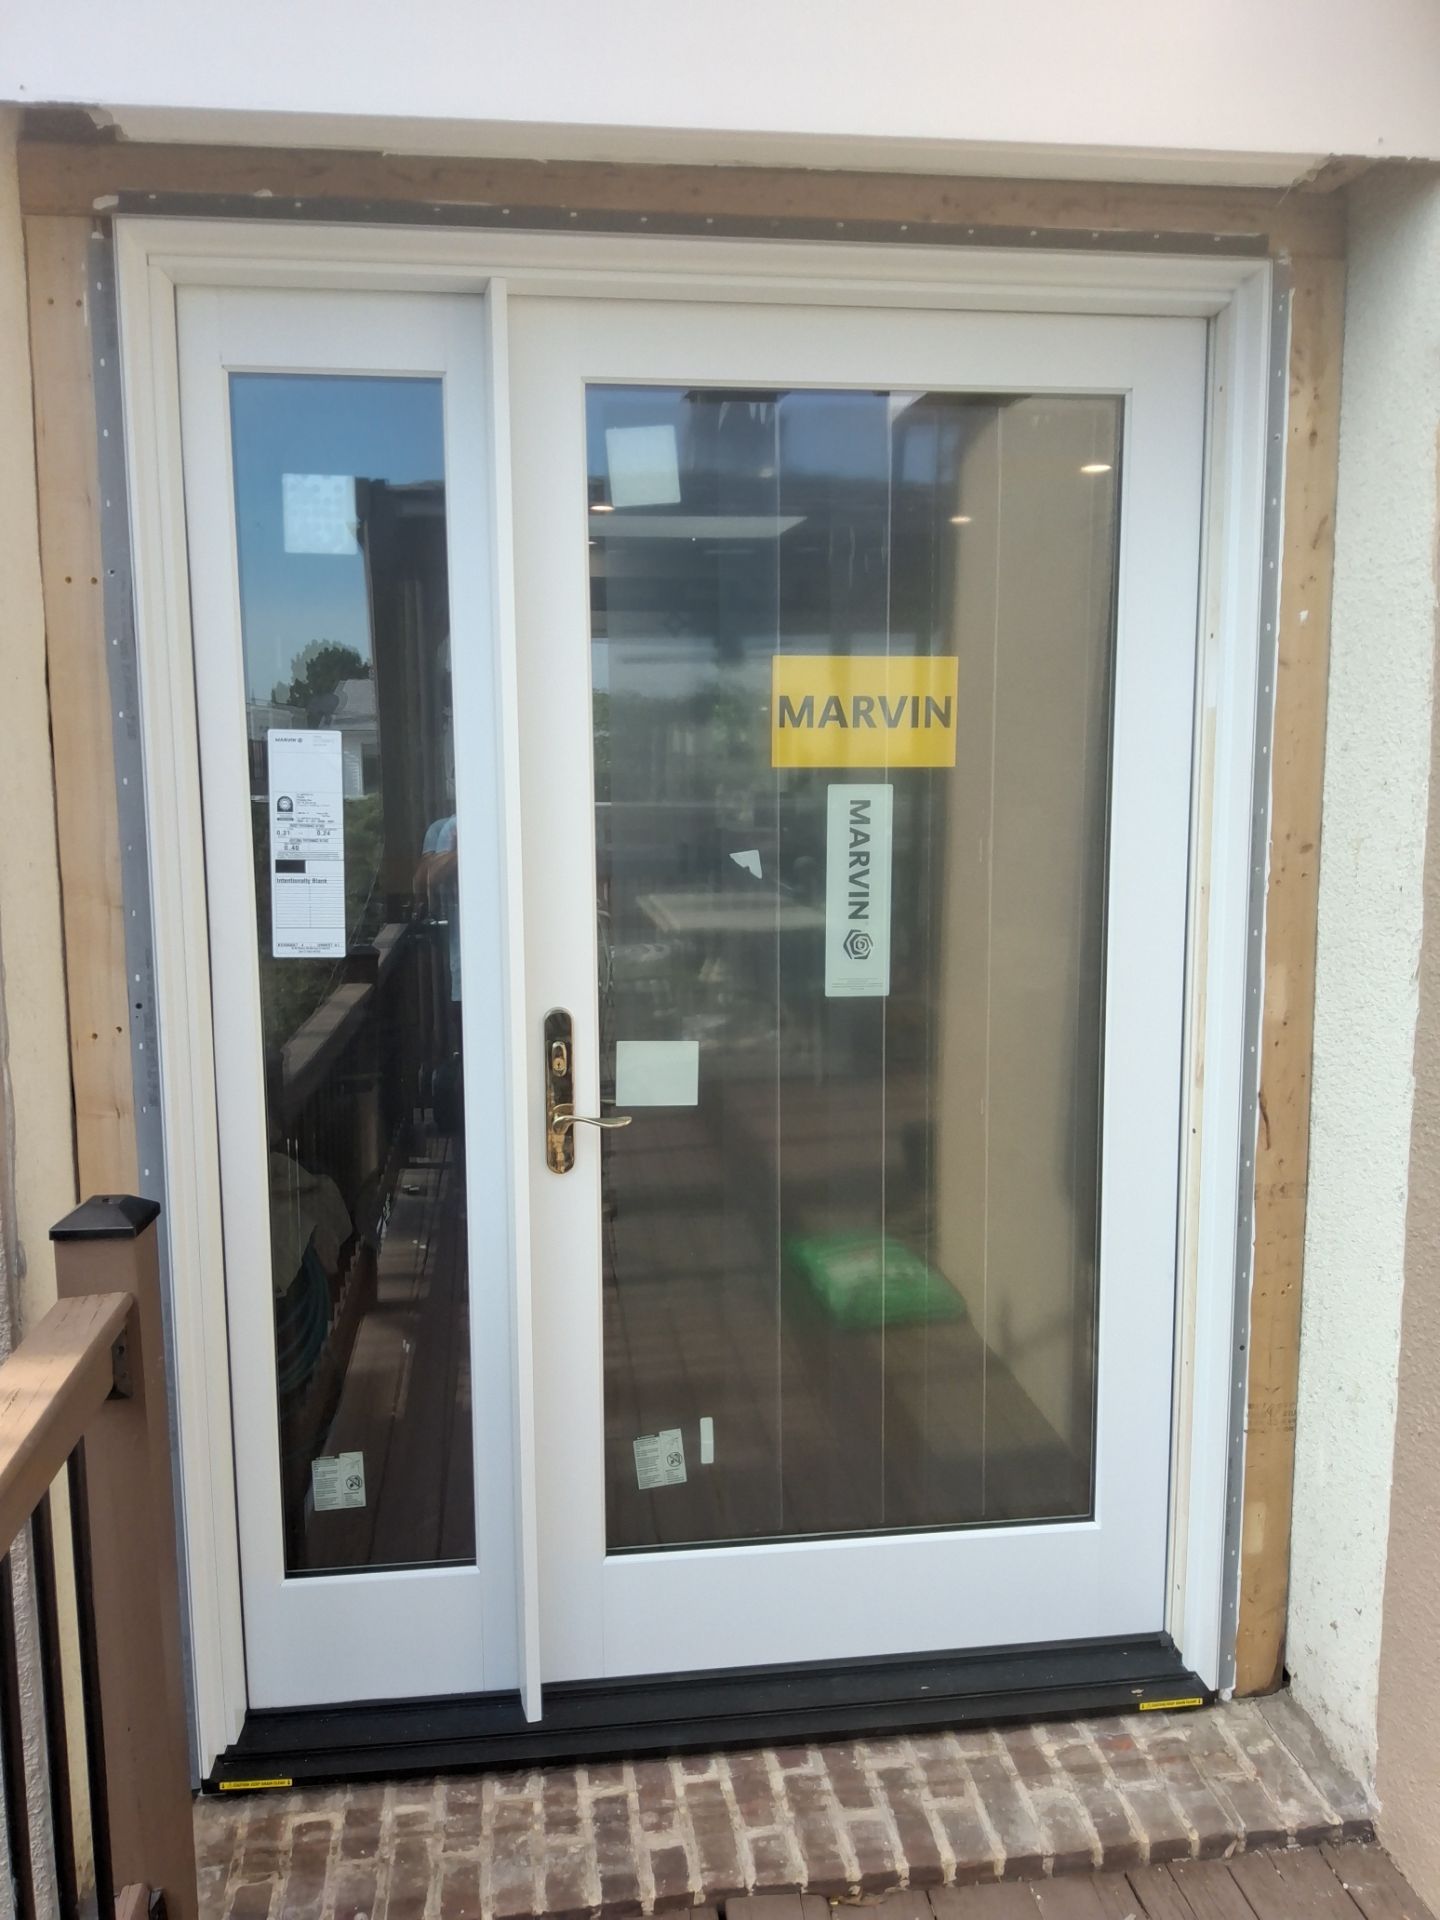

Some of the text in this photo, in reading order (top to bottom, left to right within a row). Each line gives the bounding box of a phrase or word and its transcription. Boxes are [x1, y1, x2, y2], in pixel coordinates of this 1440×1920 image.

[778, 695, 952, 729] MARVIN
[847, 799, 872, 920] MARVIN
[276, 877, 311, 885] Intentionally
